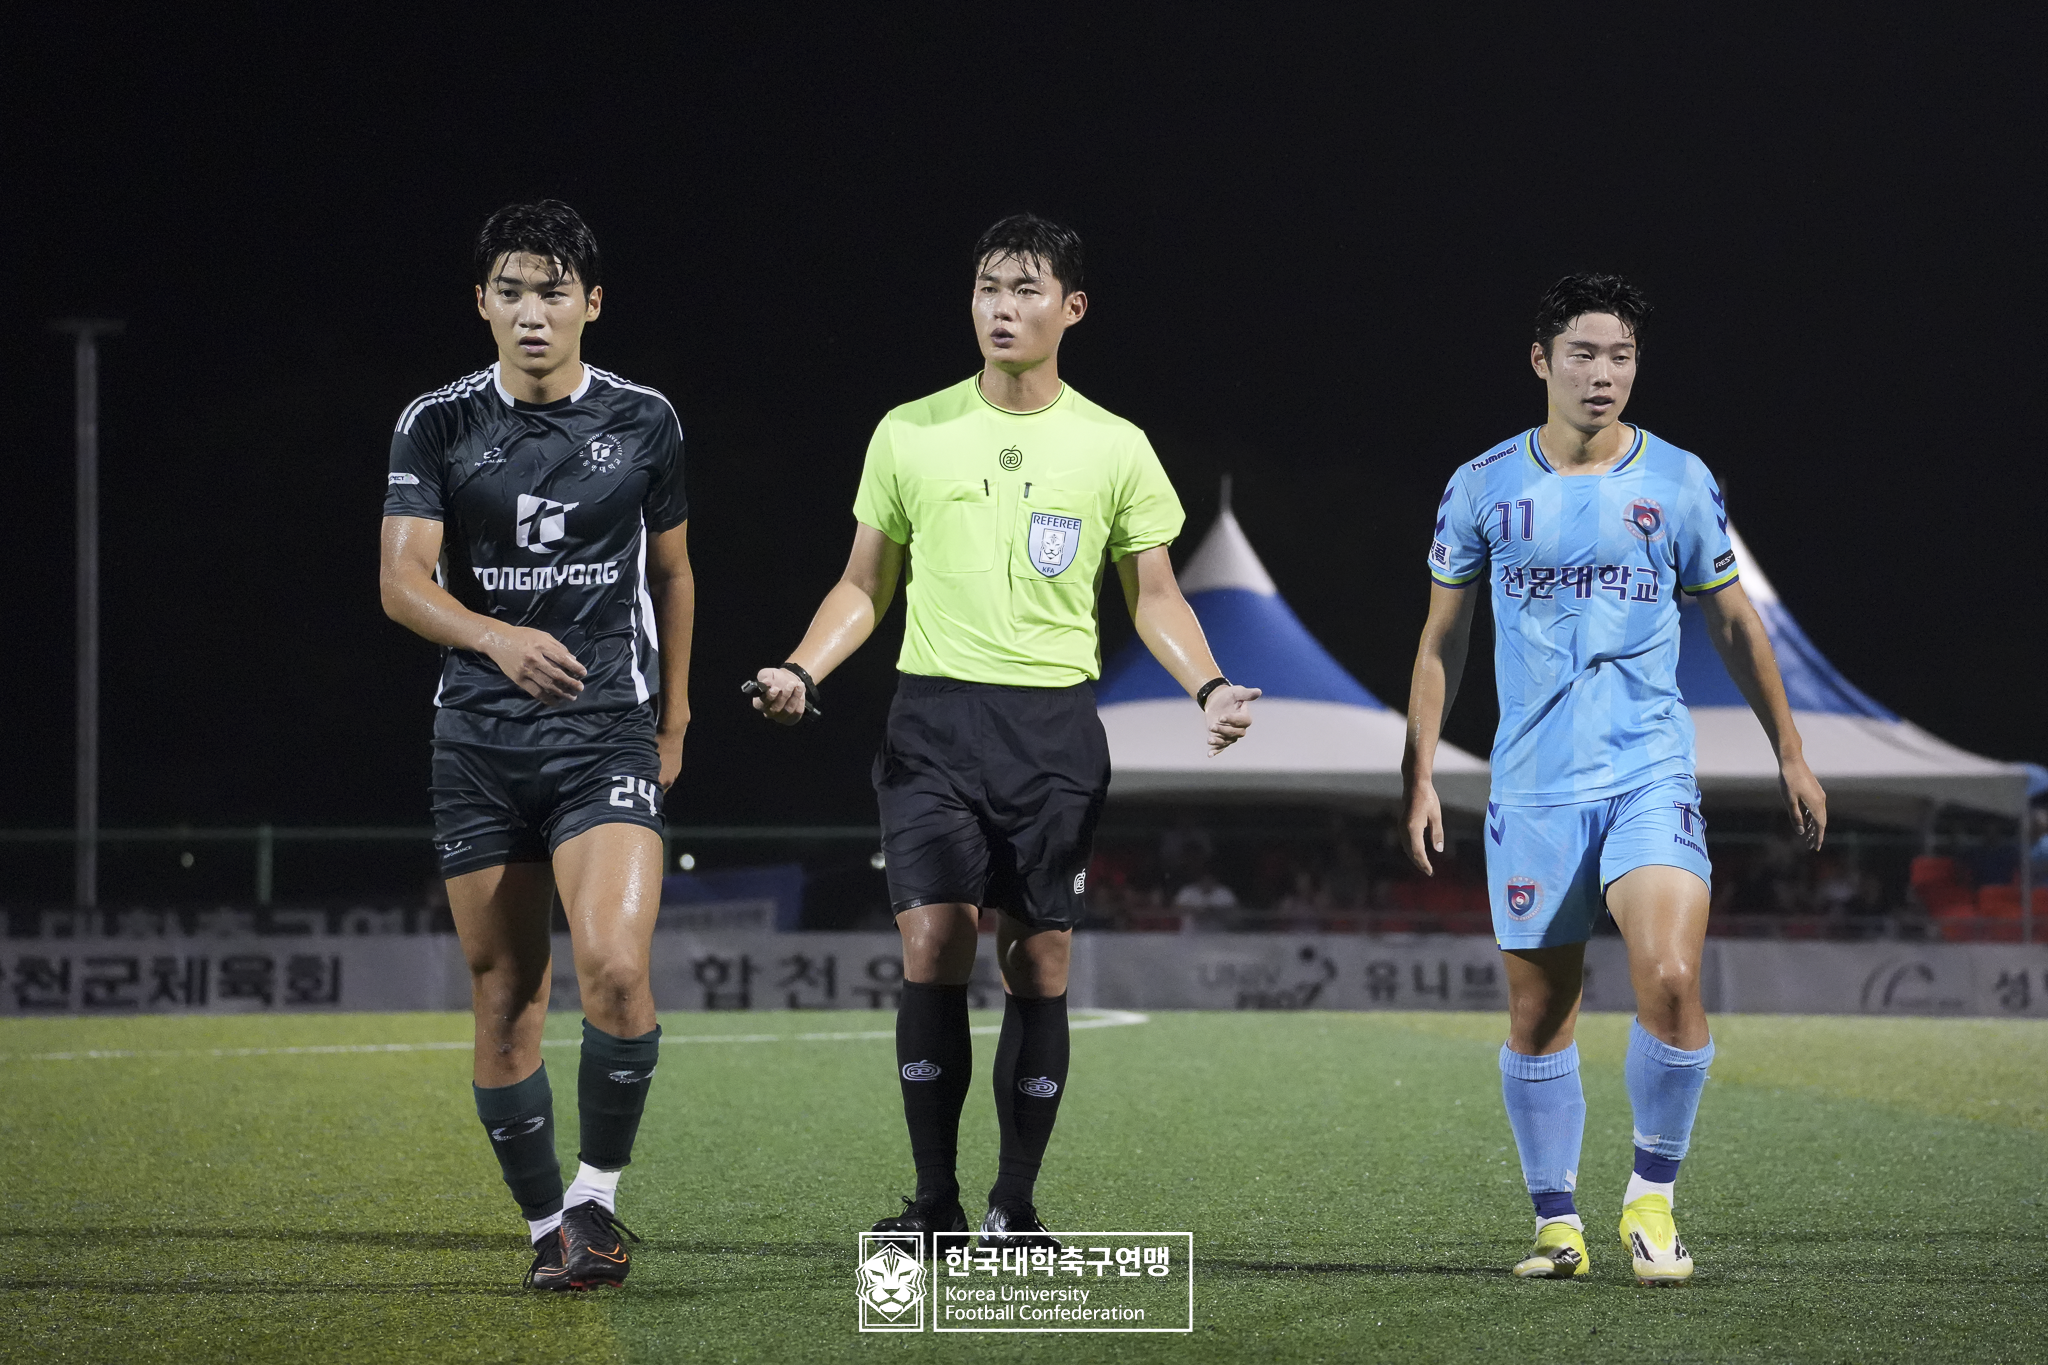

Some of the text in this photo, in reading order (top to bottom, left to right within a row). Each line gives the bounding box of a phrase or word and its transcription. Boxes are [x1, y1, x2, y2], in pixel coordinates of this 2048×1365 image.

[1471, 443, 1517, 472] hummel
[1033, 514, 1080, 530] REFEREE
[1495, 498, 1533, 542] 11
[1042, 566, 1055, 574] KFA
[1500, 564, 1658, 603] 선문대학교
[609, 775, 657, 817] 24
[0, 953, 342, 1009] 천군체육회
